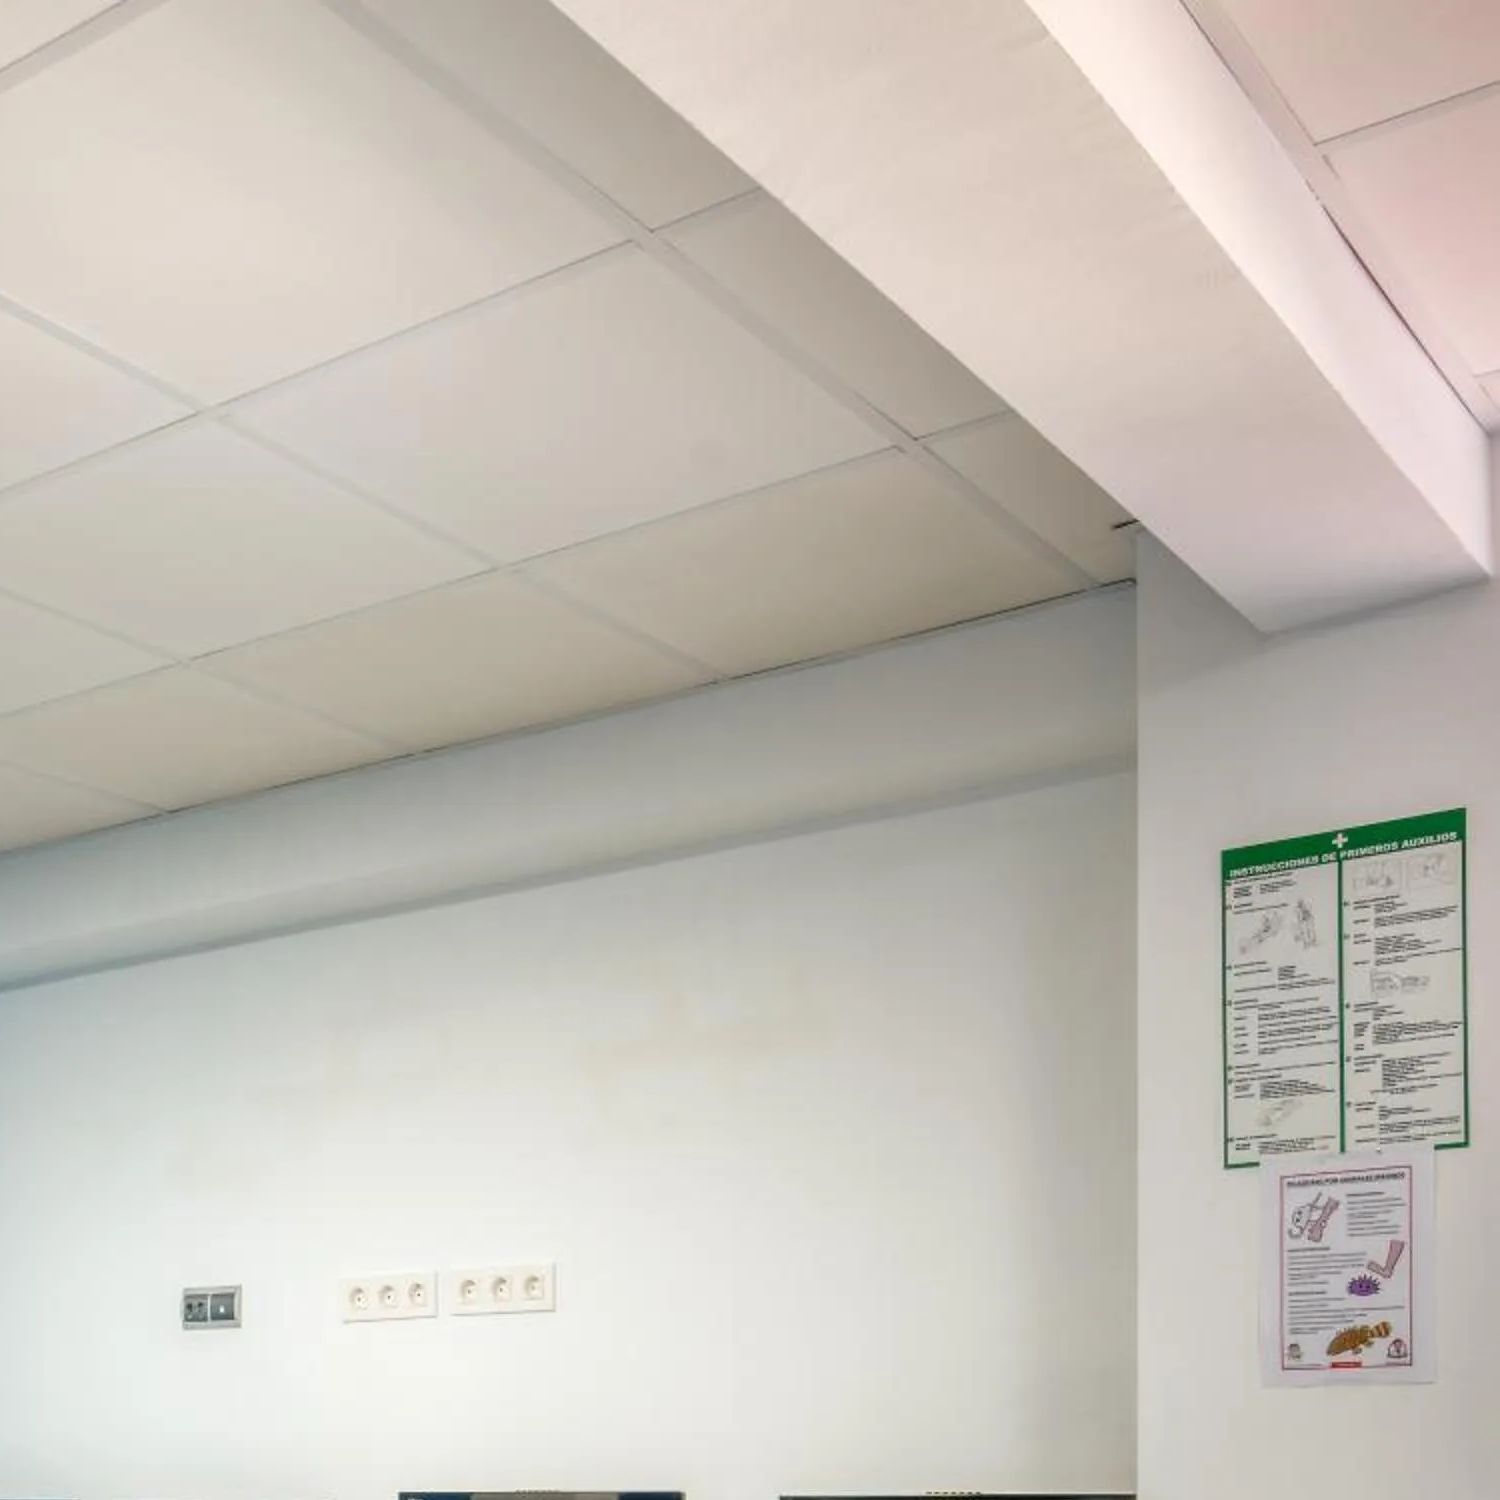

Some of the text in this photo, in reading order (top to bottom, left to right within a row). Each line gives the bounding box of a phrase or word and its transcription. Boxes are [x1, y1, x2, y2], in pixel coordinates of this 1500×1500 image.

[1229, 831, 1458, 878] INSTRUCCIONES DE PRIMEROS AUXILIOS
